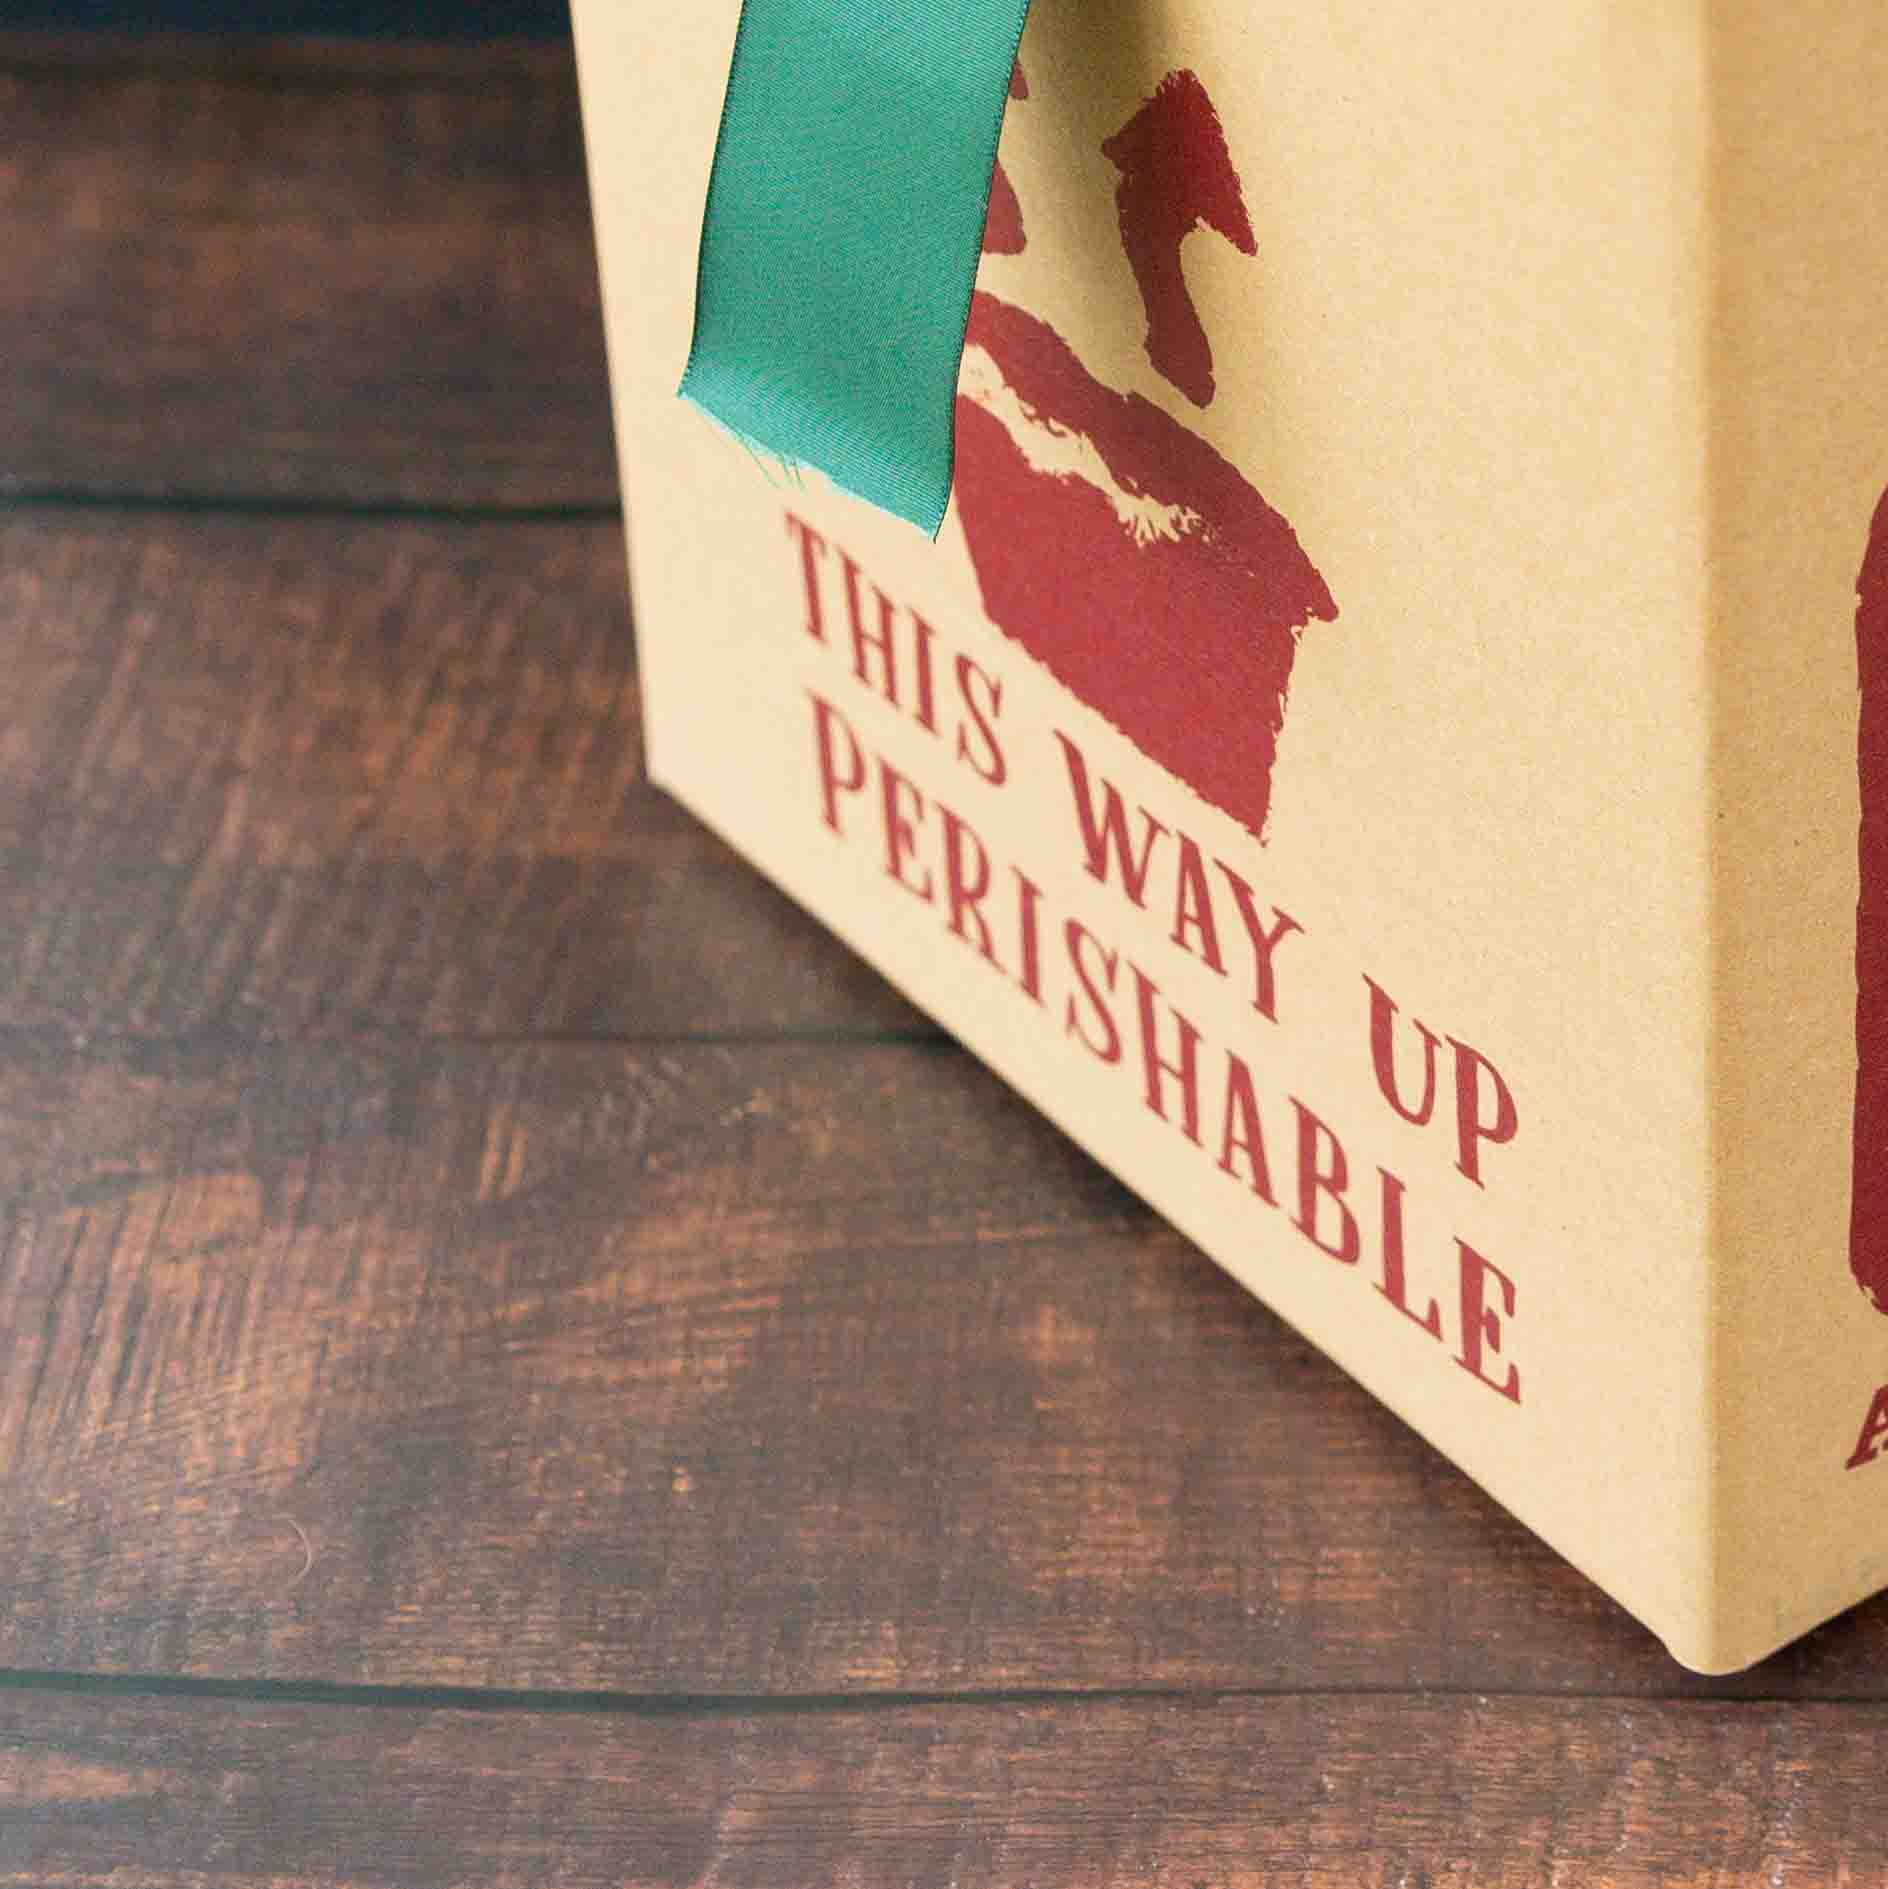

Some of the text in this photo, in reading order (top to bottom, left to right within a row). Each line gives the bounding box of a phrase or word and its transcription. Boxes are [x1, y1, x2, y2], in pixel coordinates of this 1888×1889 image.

[784, 509, 1520, 1190] THIS WAY UP
[804, 684, 1524, 1406] PERISHABLE
